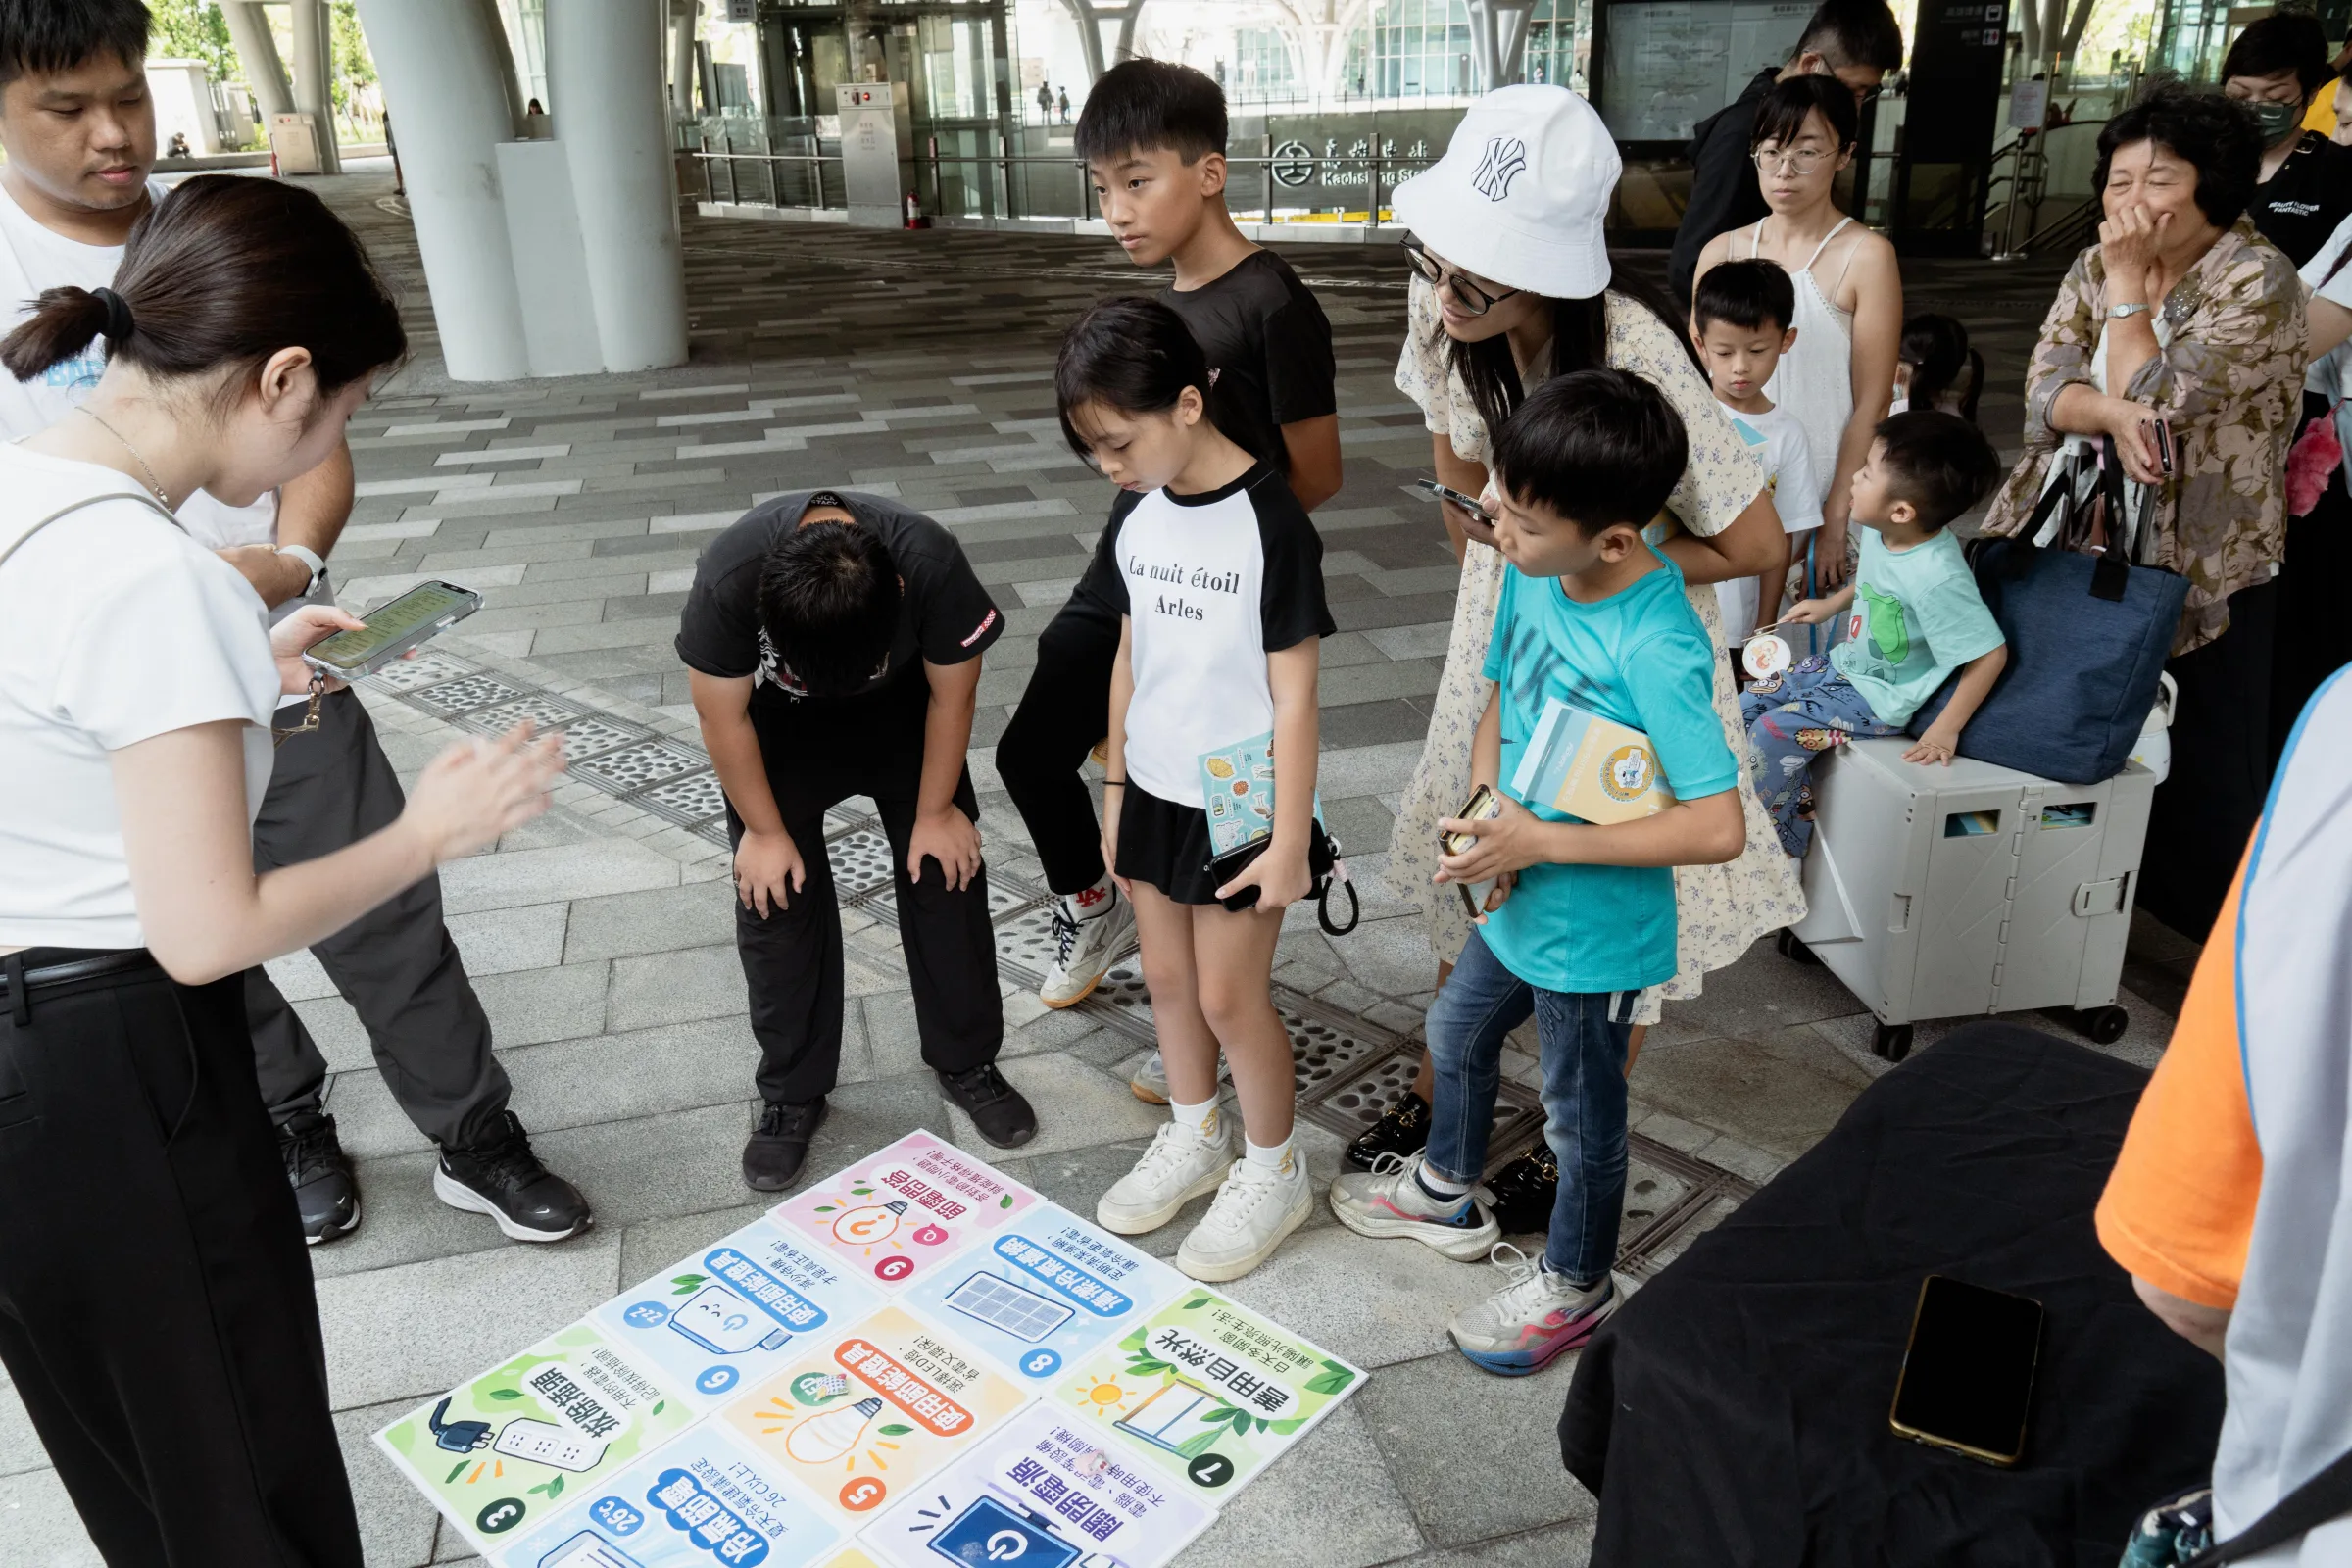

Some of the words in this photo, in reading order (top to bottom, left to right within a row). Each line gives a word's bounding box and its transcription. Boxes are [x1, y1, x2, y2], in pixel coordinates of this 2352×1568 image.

[1321, 171, 1396, 186] Kaohsing
[1129, 555, 1145, 576] La
[1150, 563, 1184, 585] nuit
[1191, 567, 1240, 594] étoil
[1154, 594, 1203, 621] Arles
[881, 1170, 967, 1220] 節電問答
[923, 1230, 937, 1242] Q
[709, 1251, 818, 1325] 使用節能燈具
[883, 1262, 906, 1276] 9
[998, 1237, 1124, 1312] 清潔冷氣濾網
[913, 1335, 980, 1382] 省電又環保!
[1028, 1354, 1053, 1372] 8
[1154, 1329, 1290, 1413] 善用自然光
[710, 1371, 730, 1389] 6
[798, 1376, 820, 1397] ED
[841, 1343, 967, 1431] 使用節能燈具
[529, 1367, 620, 1439] 拔除插頭
[1196, 1462, 1222, 1482] 7
[690, 1457, 789, 1540] 夏天冷氣建議設定
[848, 1484, 878, 1506] 5
[1004, 1456, 1124, 1543] 關閉電源
[485, 1504, 518, 1528] 3
[655, 1474, 762, 1564] 冷氣節電
